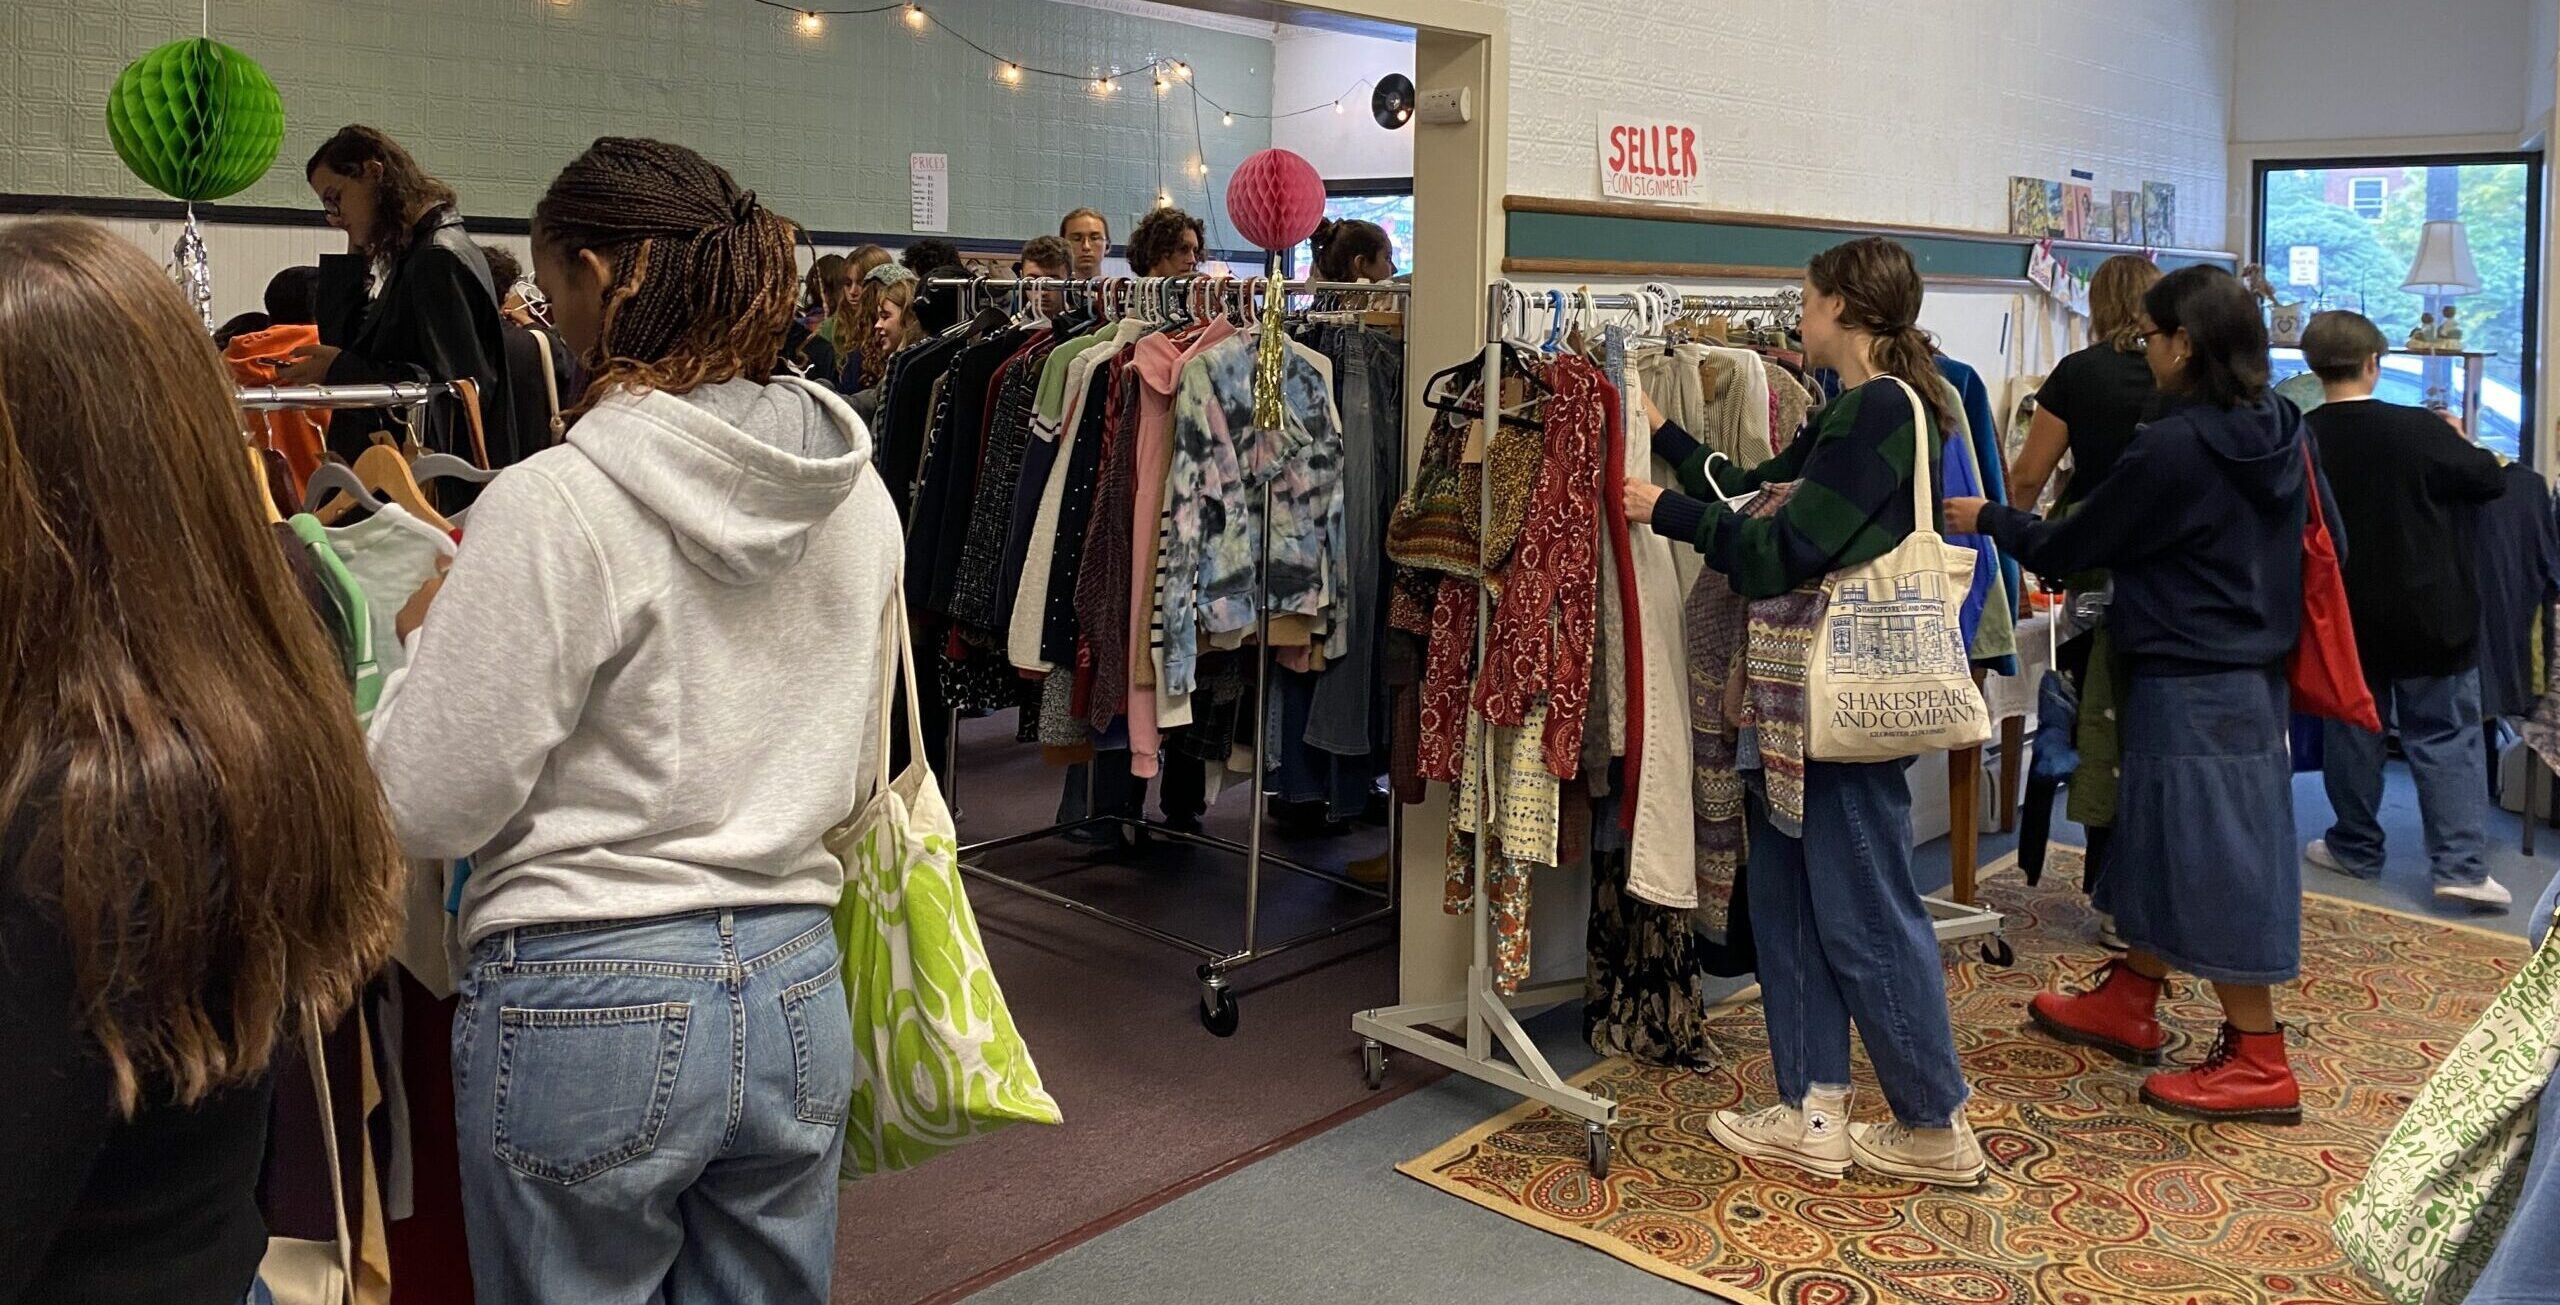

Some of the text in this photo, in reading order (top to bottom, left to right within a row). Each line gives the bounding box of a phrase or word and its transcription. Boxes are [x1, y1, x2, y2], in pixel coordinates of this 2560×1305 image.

[912, 156, 945, 169] PRICES
[1608, 125, 1697, 178] SELLER
[1612, 173, 1689, 197] CONSIGNMENT
[1837, 687, 1971, 711] SHAKESPEARE
[1830, 705, 1976, 729] AND COMPANY
